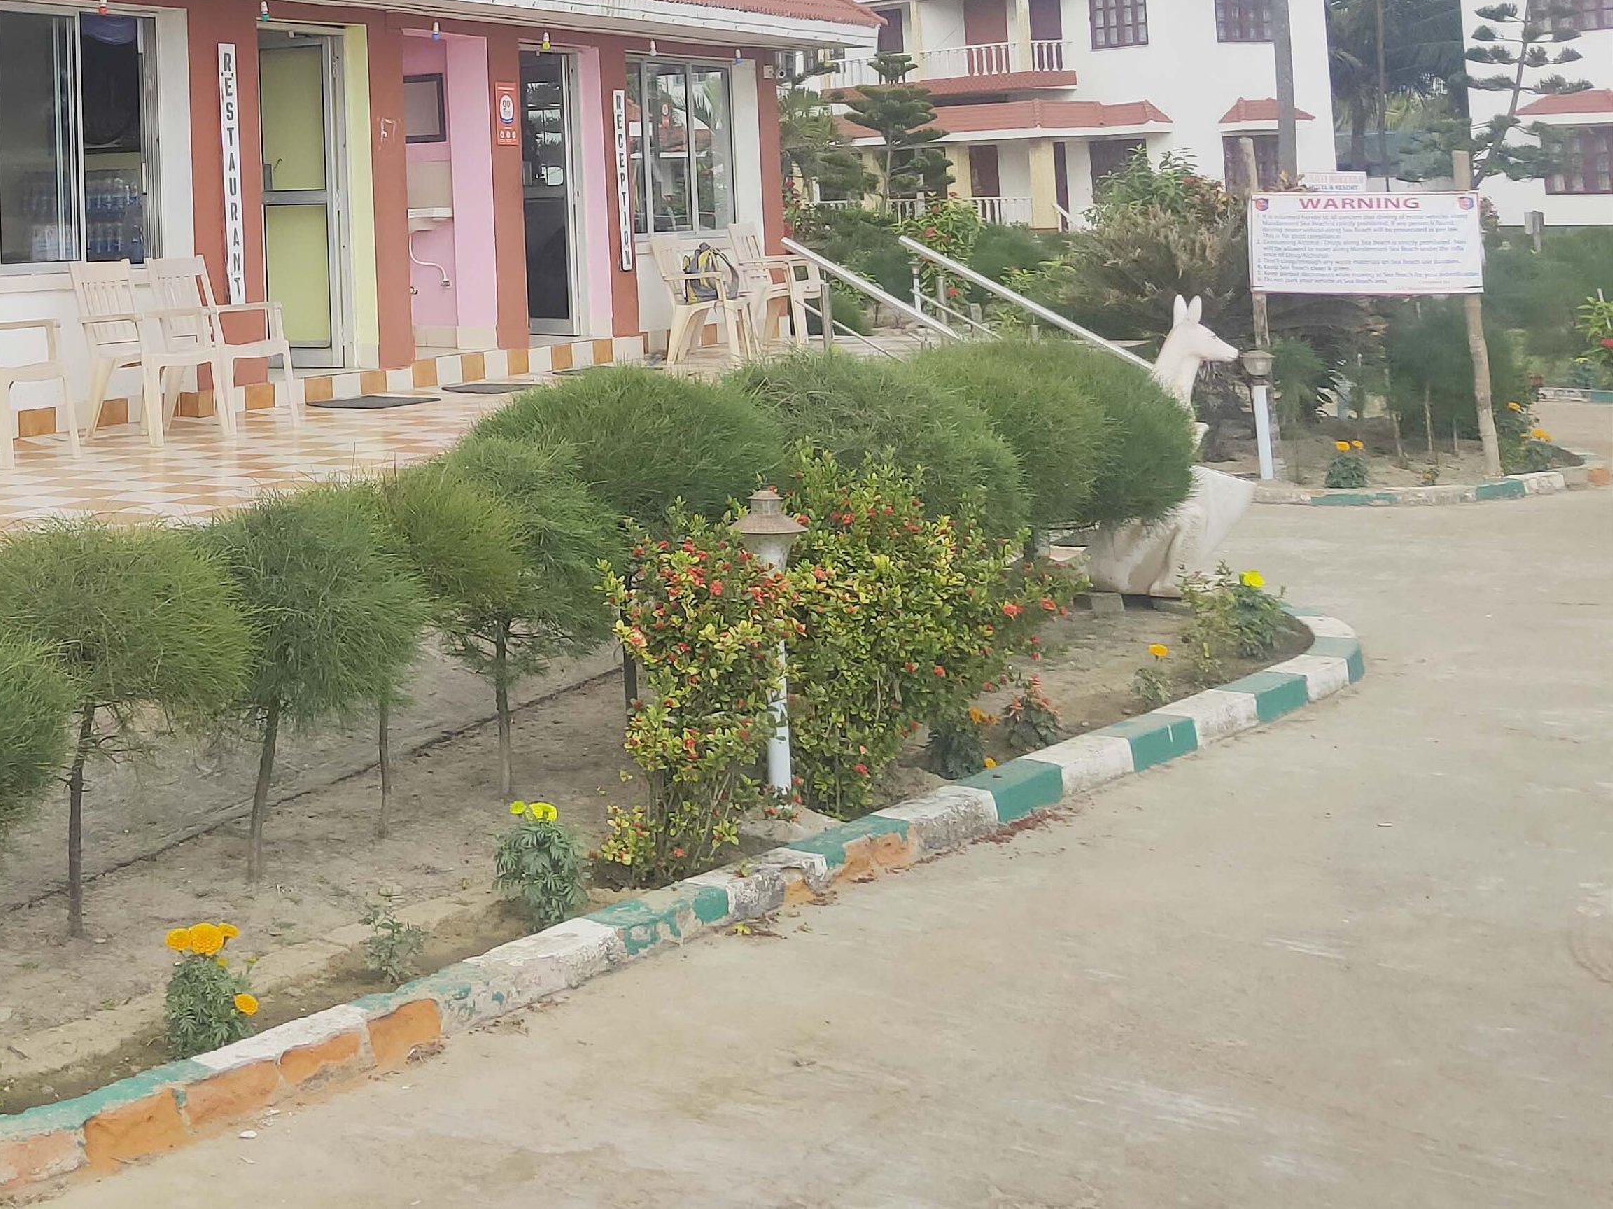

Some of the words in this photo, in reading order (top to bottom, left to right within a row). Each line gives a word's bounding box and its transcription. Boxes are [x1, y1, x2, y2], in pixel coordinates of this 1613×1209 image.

[222, 51, 243, 300] RESTAURANT
[614, 94, 632, 267] RECEPTION
[1299, 196, 1421, 210] WARNING
